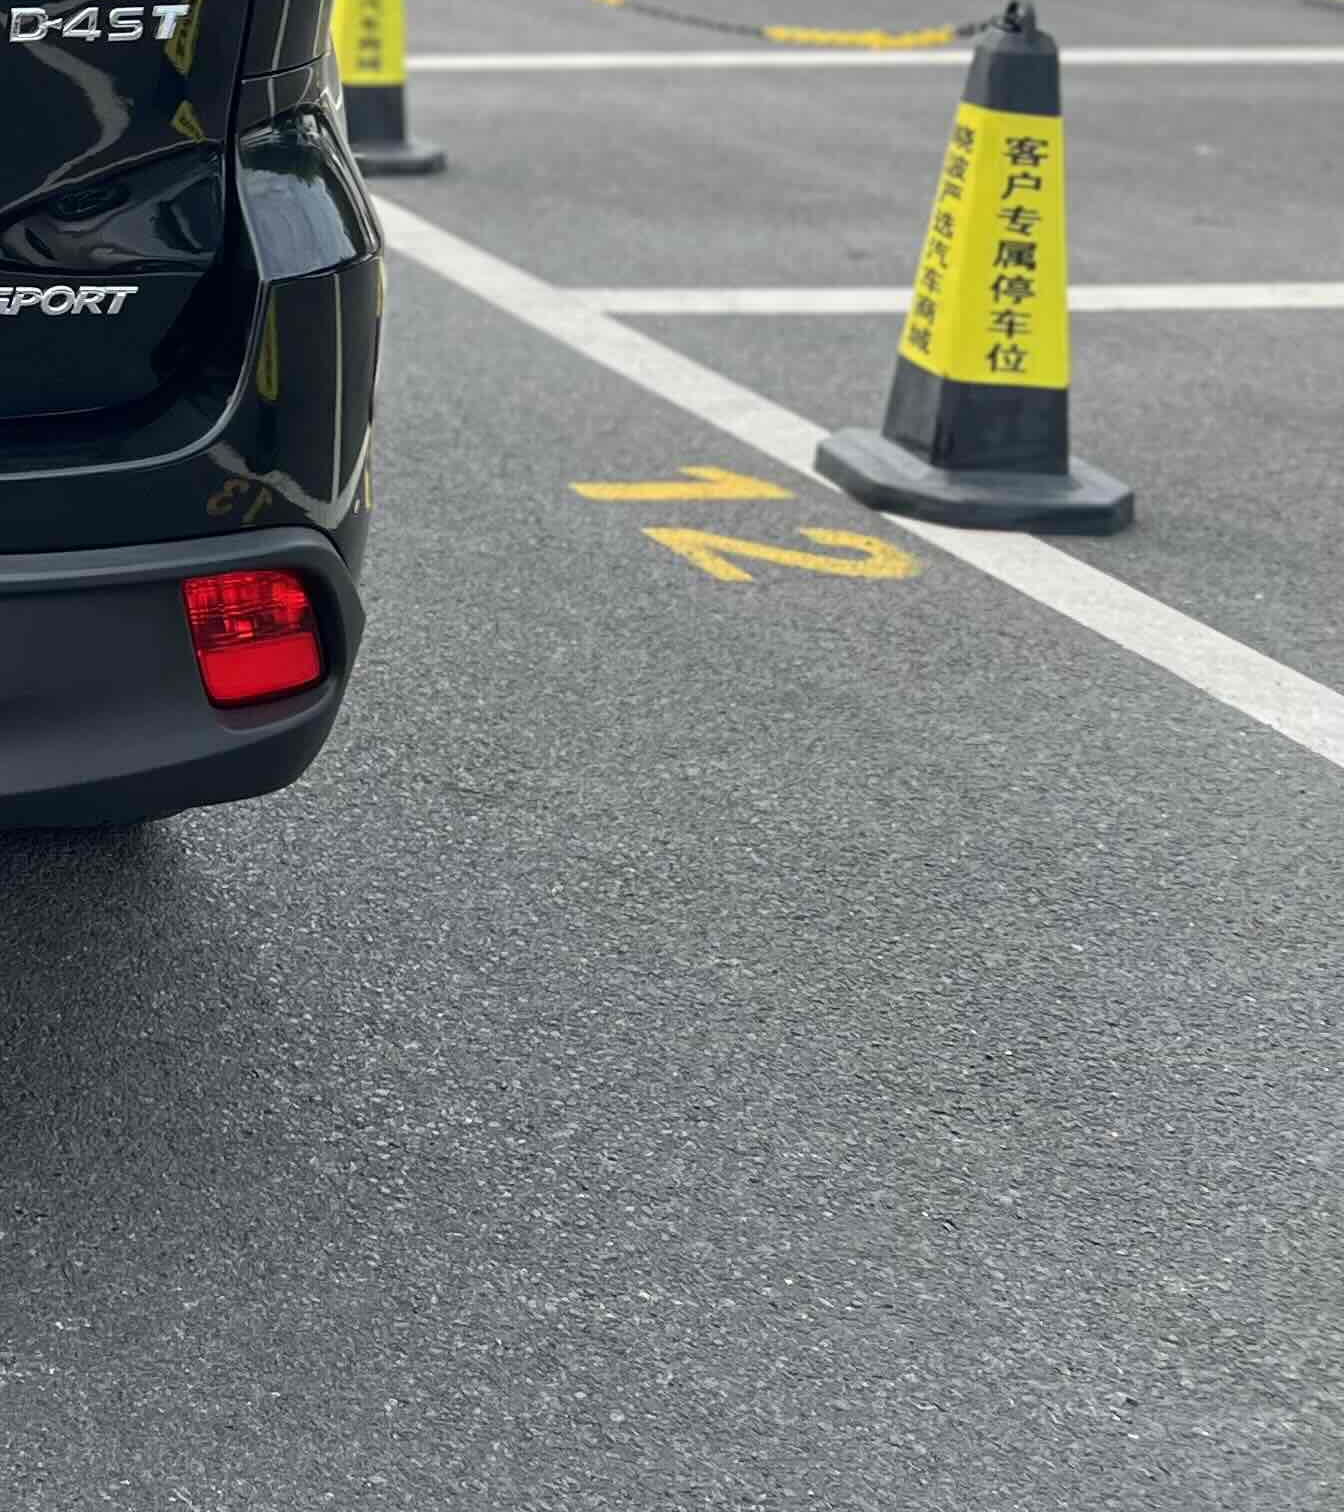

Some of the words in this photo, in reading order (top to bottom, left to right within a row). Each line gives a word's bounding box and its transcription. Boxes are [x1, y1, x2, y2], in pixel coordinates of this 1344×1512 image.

[983, 135, 1049, 375] 客户专属停车位
